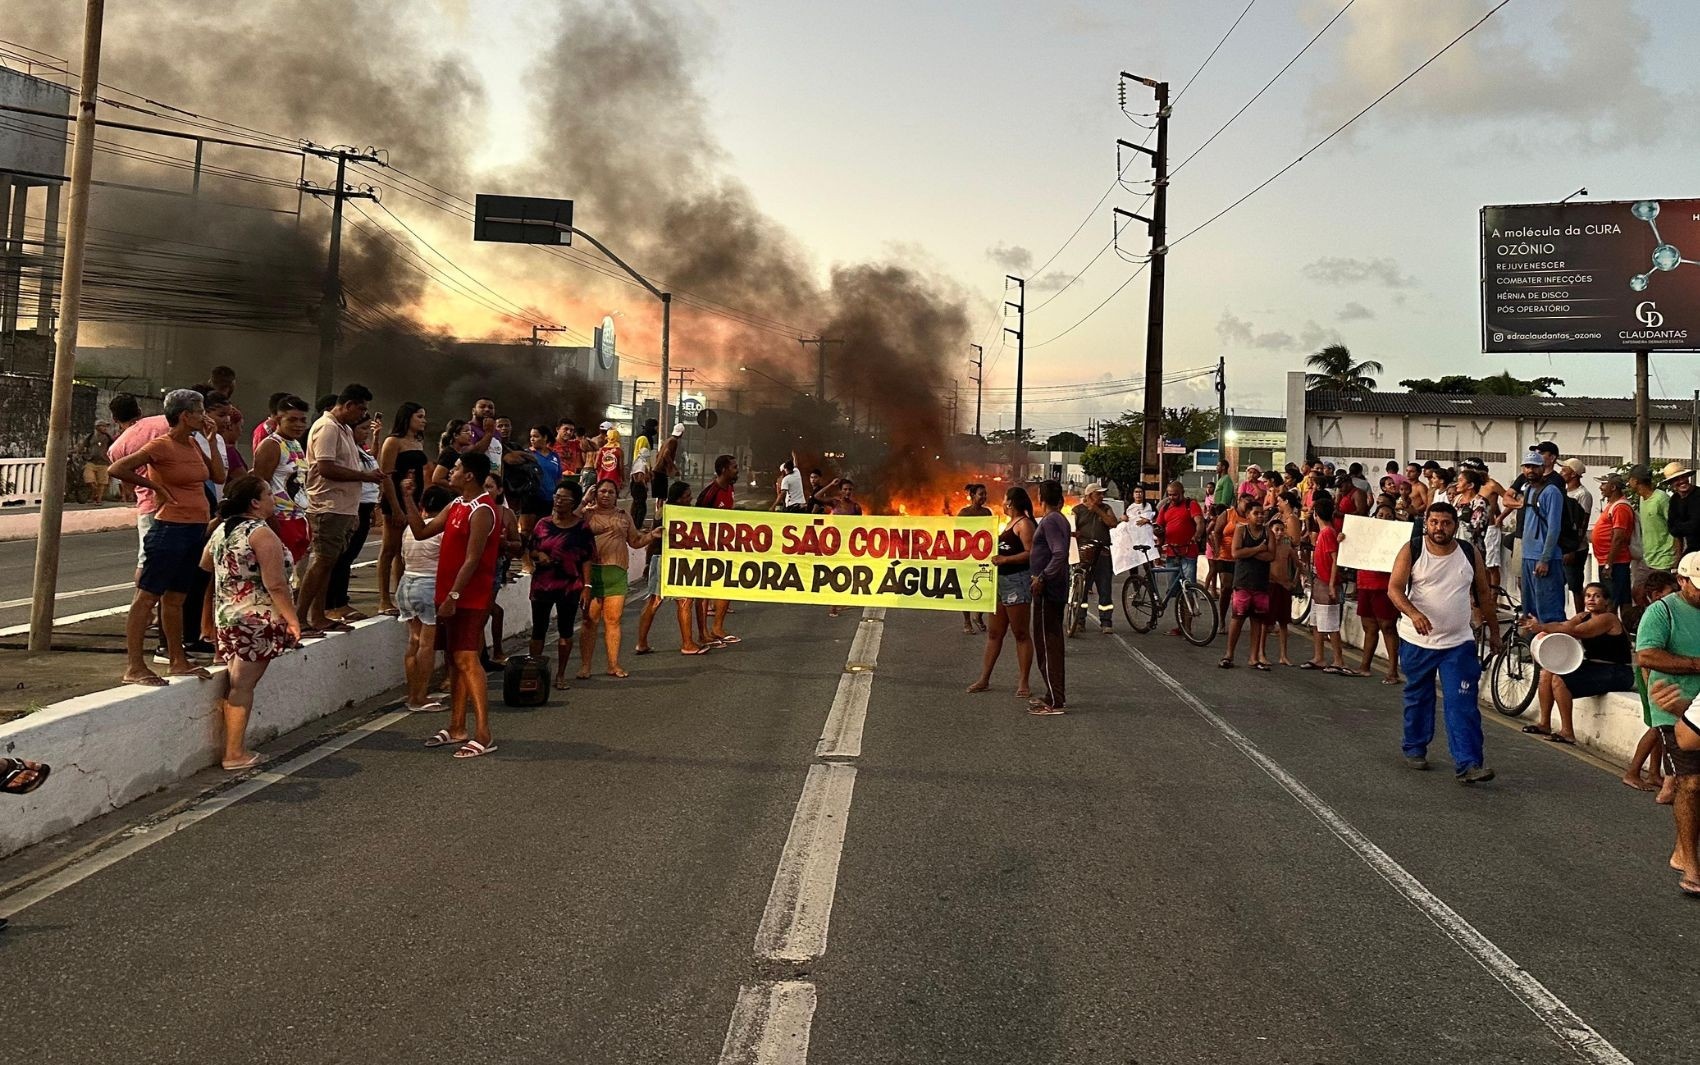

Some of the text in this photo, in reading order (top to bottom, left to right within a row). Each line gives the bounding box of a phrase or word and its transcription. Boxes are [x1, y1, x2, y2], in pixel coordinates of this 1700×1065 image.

[1491, 223, 1621, 238] A molécula da CURA
[1497, 242, 1555, 256] OZÔNIO
[1496, 261, 1565, 270] REJUVENESCER
[1496, 274, 1593, 285] COMBATER INFECÇÕES
[1497, 291, 1569, 300] HÉRNIA DE DISCO
[1497, 303, 1570, 313] PÓS OPERATÓRIO
[1619, 330, 1688, 339] CLAUDANTAS
[668, 518, 993, 561] BAIRRO SÃO CONRADO
[667, 557, 964, 600] IMPLORA POR ÁGUA
